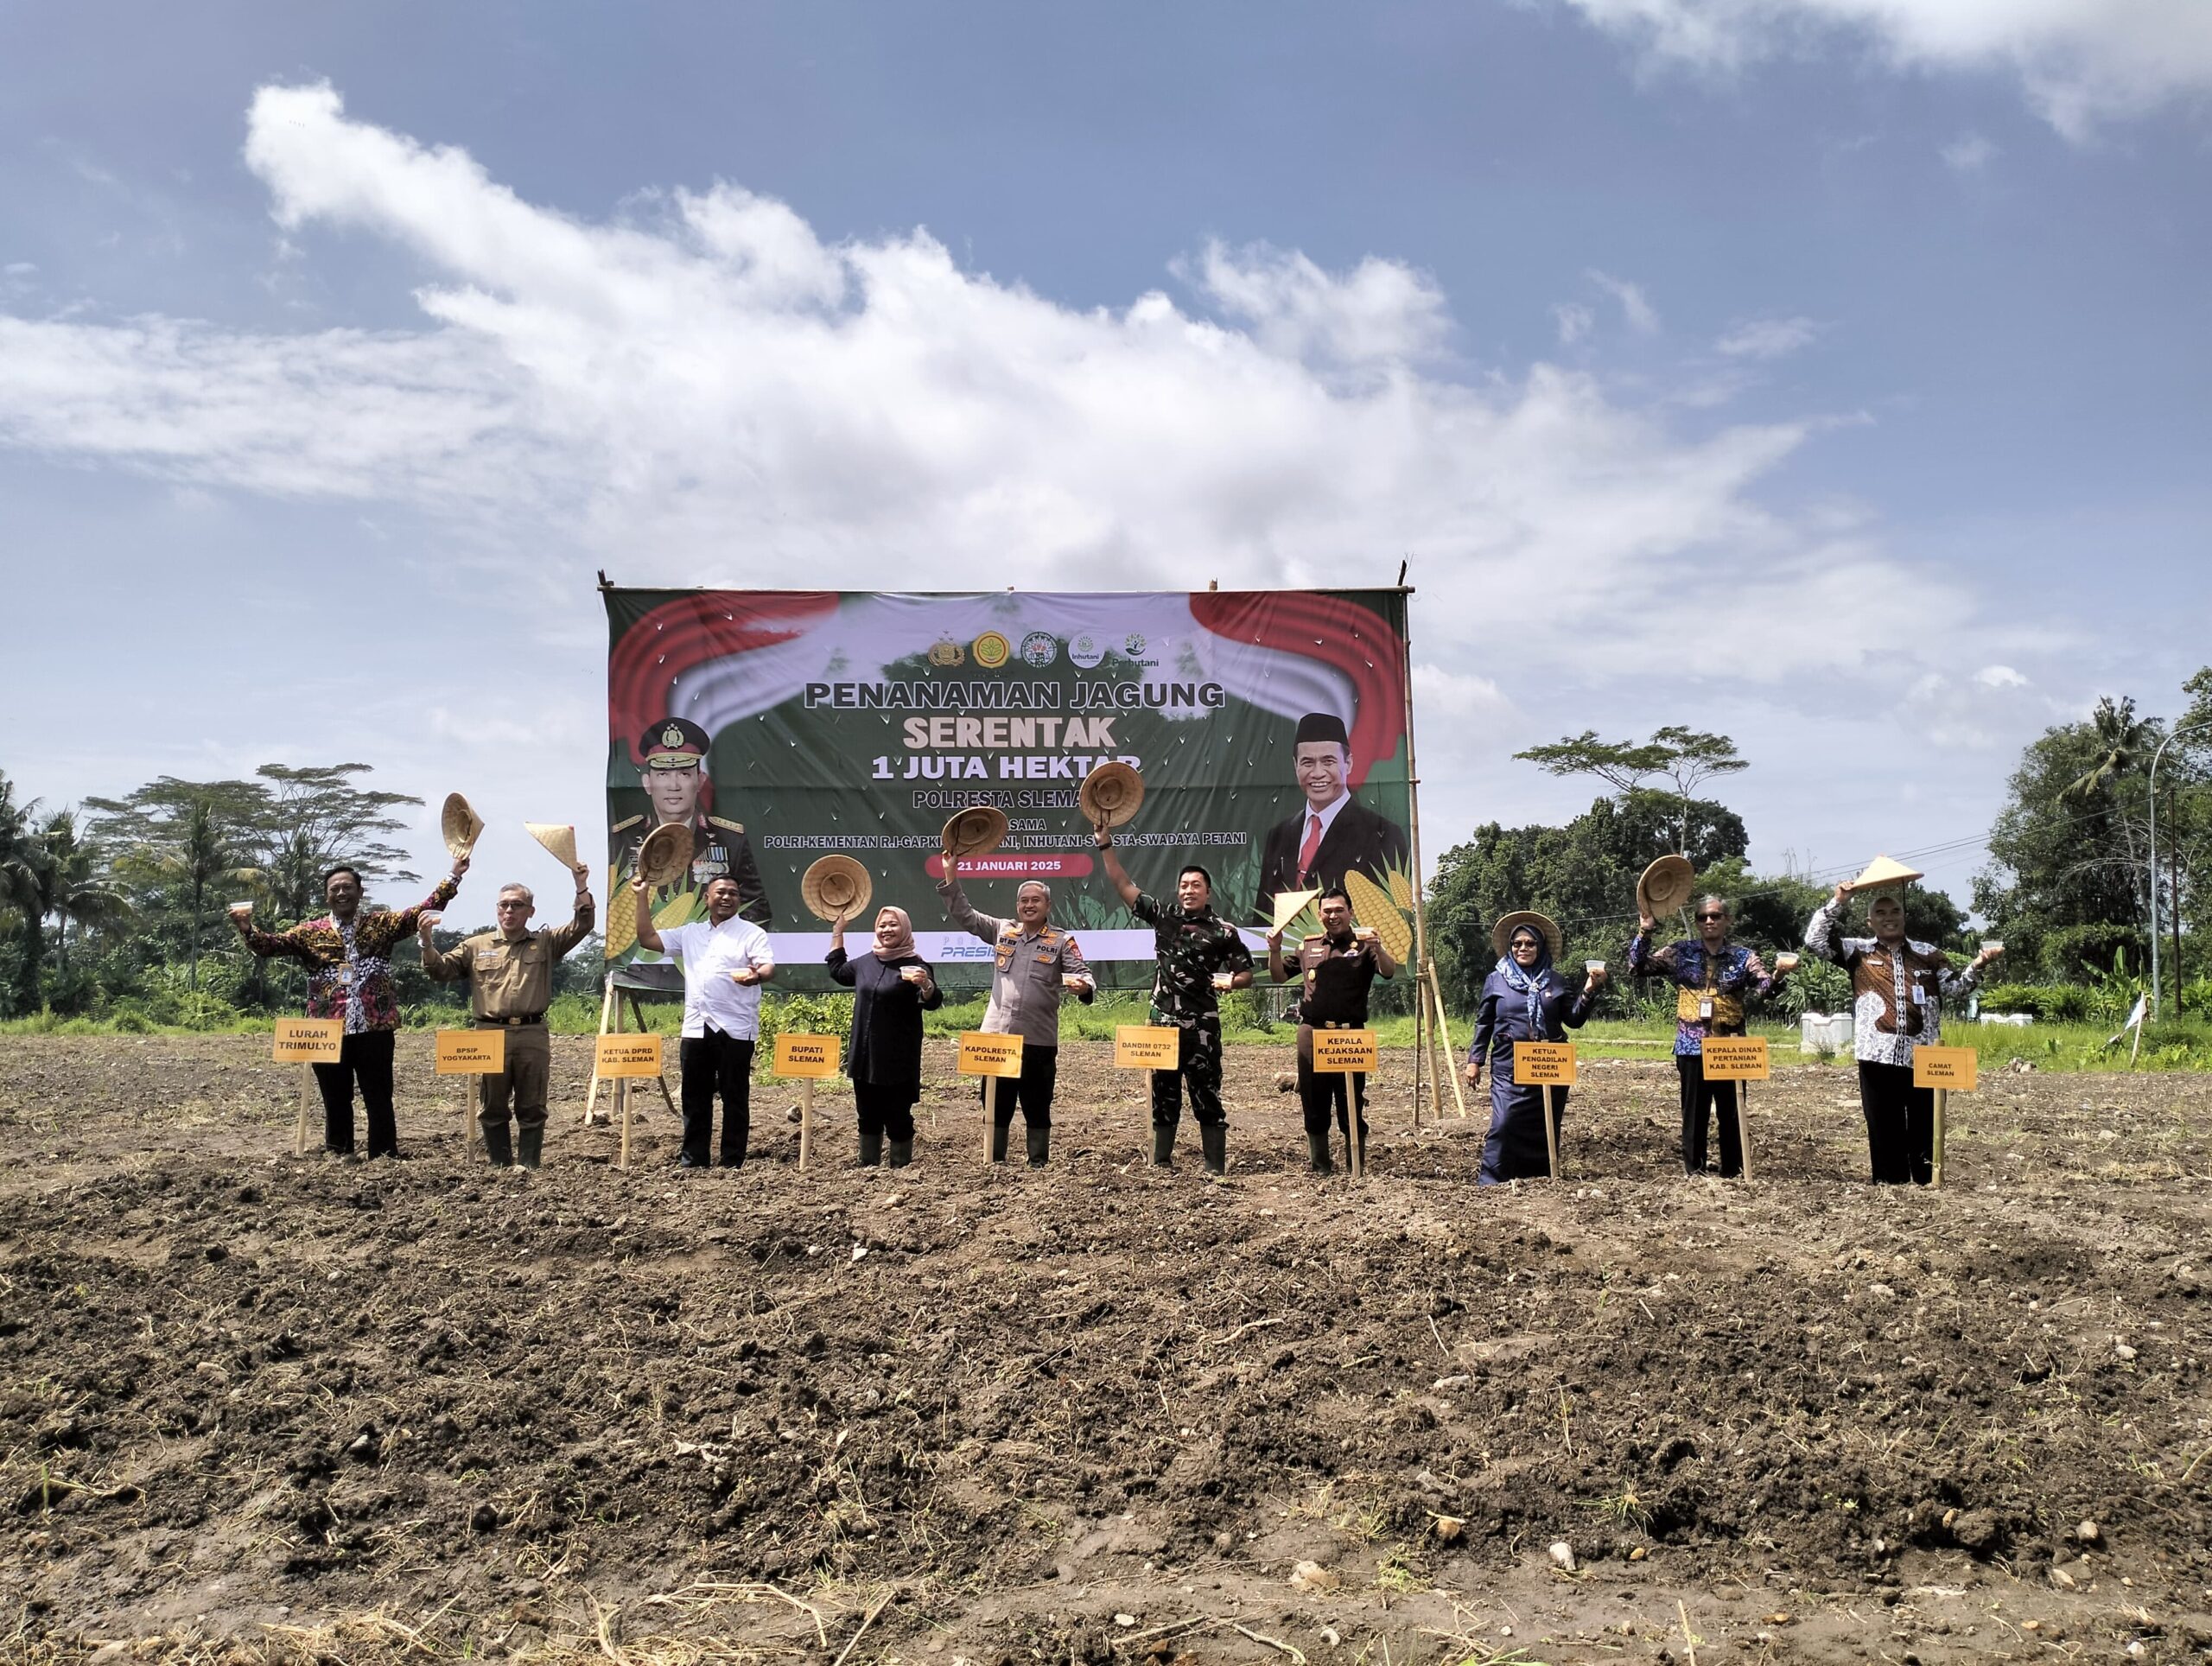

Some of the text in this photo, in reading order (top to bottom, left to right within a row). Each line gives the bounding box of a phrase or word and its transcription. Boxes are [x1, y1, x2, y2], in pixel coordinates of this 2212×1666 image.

[1112, 658, 1159, 667] Phutani
[804, 682, 1225, 709] PENANAMAN JAGUNG
[903, 717, 1116, 749] SERENTAK
[872, 757, 893, 779] 1
[902, 757, 990, 779] JUTA
[913, 790, 1081, 808] POLRESTA SLEMA
[764, 836, 878, 848] POLRI-KEMENTAN
[1023, 833, 1200, 847] INHUTANI-SSTA-SWADAYA
[1203, 832, 1247, 845] PETANI
[957, 861, 1061, 871] 21 JANUARI 2025
[941, 947, 995, 957] PRESI
[1037, 945, 1058, 954] POLRI
[289, 1029, 328, 1039] LURAH
[279, 1041, 336, 1051] TRIMULYO
[964, 1046, 1017, 1056] KAPOLRESTA
[788, 1055, 825, 1064] SLEMAN
